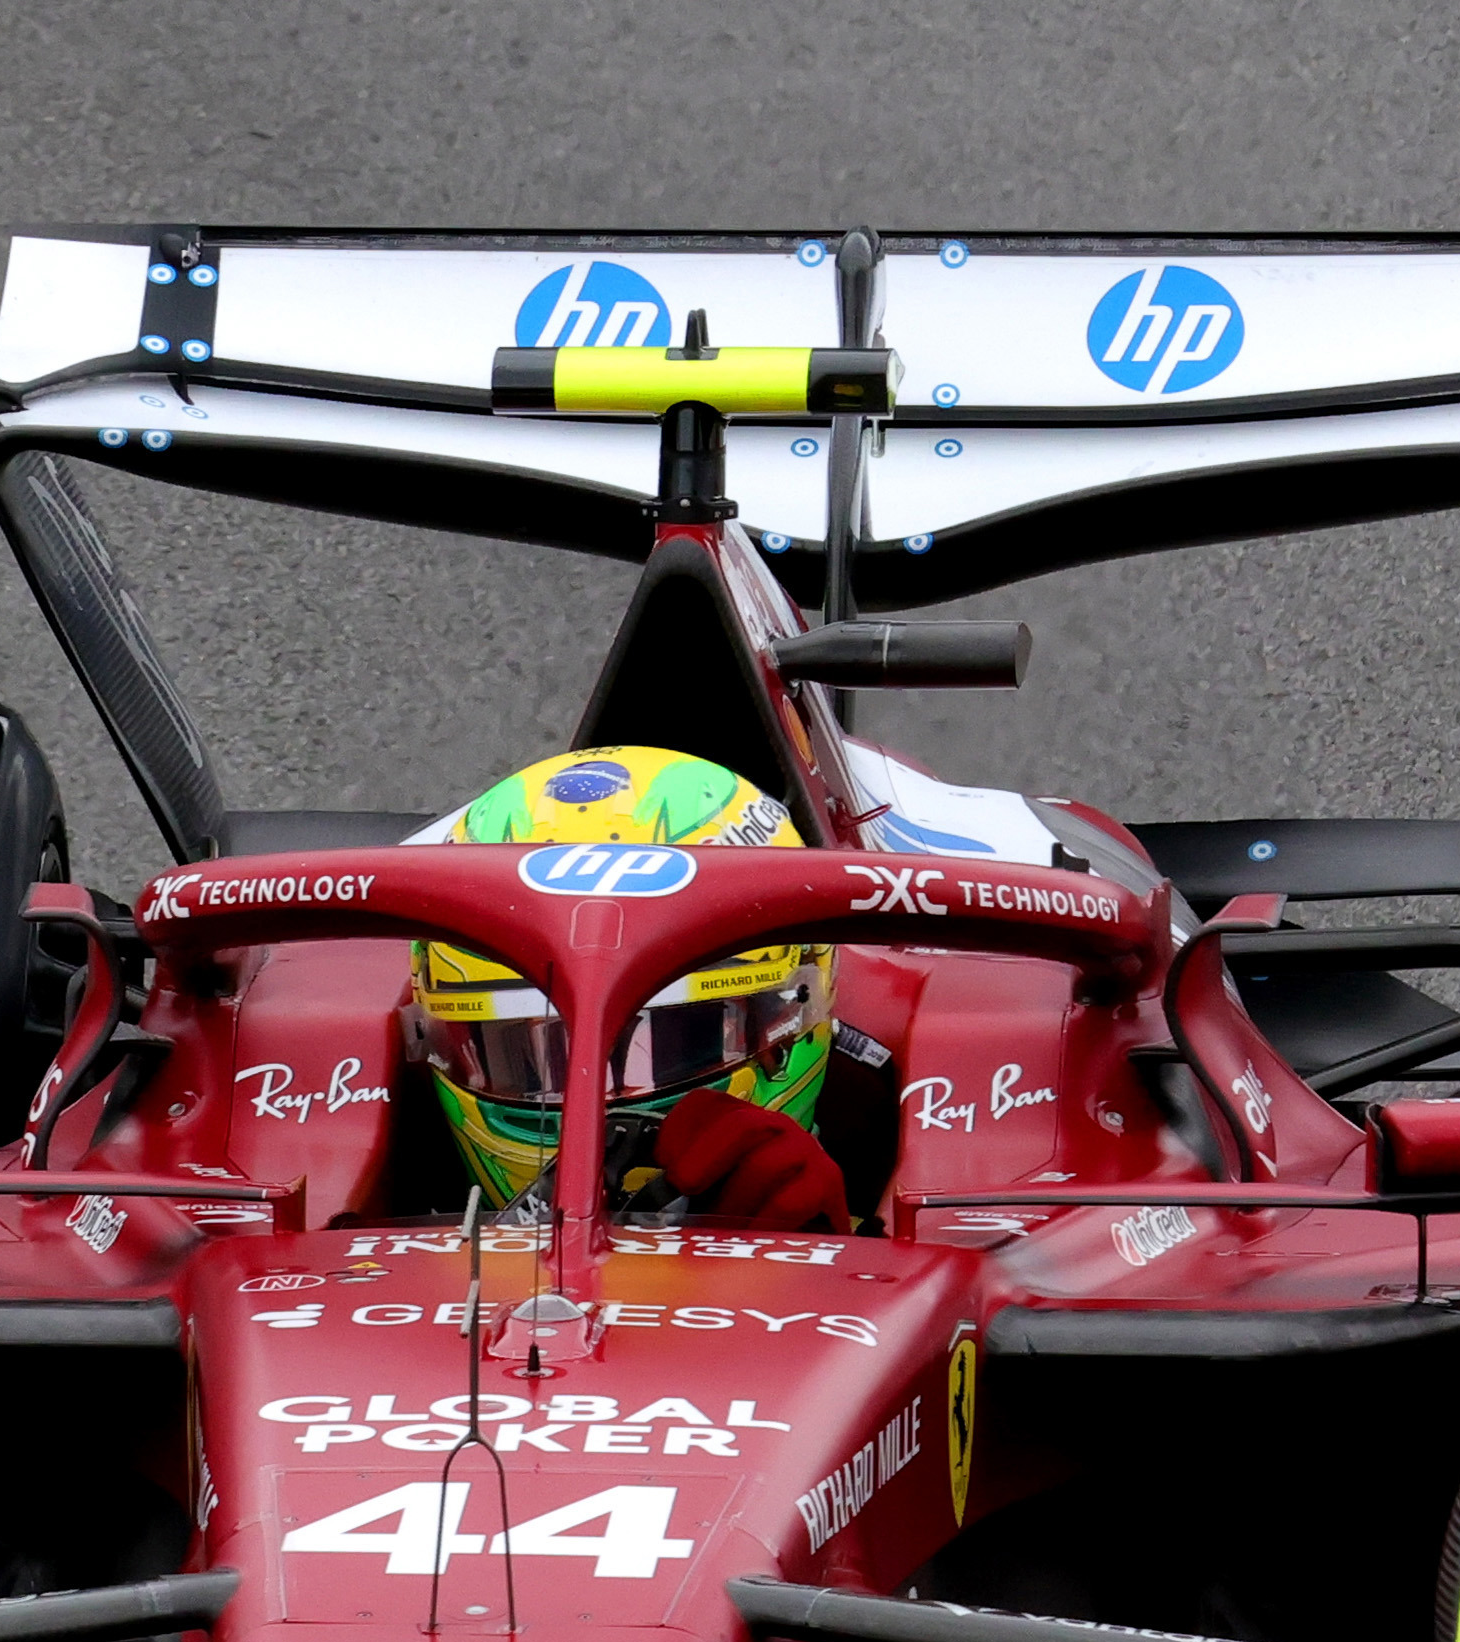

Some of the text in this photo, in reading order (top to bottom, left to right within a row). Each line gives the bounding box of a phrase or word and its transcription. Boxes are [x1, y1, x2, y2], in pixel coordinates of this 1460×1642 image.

[1102, 265, 1232, 394] hp
[199, 874, 375, 906] TECHNOLOGY
[542, 844, 672, 896] hp
[844, 865, 1121, 925] DXC TECHNOLOGY
[702, 971, 782, 991] RICHARD MILLE
[235, 1057, 391, 1124] Ray-Ban
[259, 1394, 792, 1433] GLOBAL
[294, 1422, 740, 1457] POKER
[795, 1394, 922, 1555] RICHARD MILLE
[281, 1481, 695, 1579] 44
